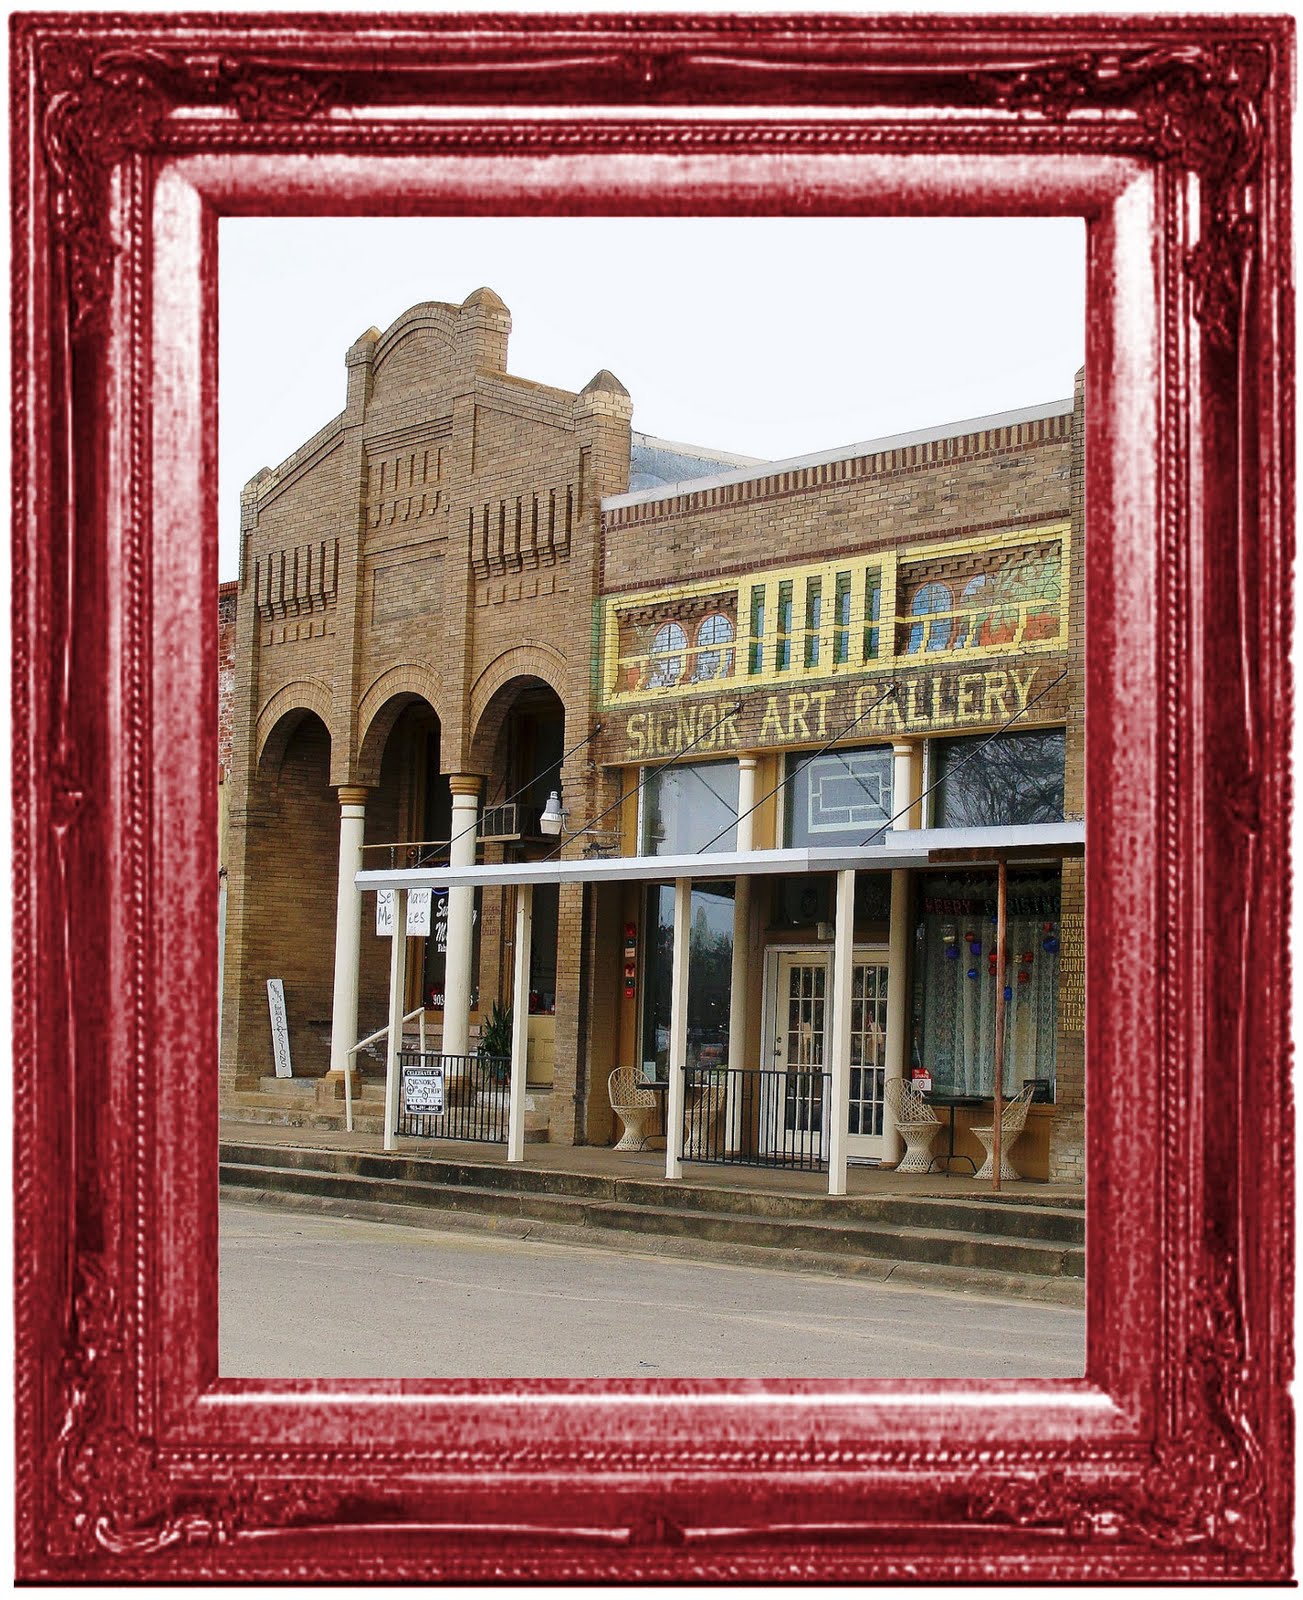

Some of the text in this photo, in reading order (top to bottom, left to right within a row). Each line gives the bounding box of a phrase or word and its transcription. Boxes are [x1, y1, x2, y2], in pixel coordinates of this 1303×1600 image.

[625, 666, 1040, 762] SIGNOR ART GALLERY
